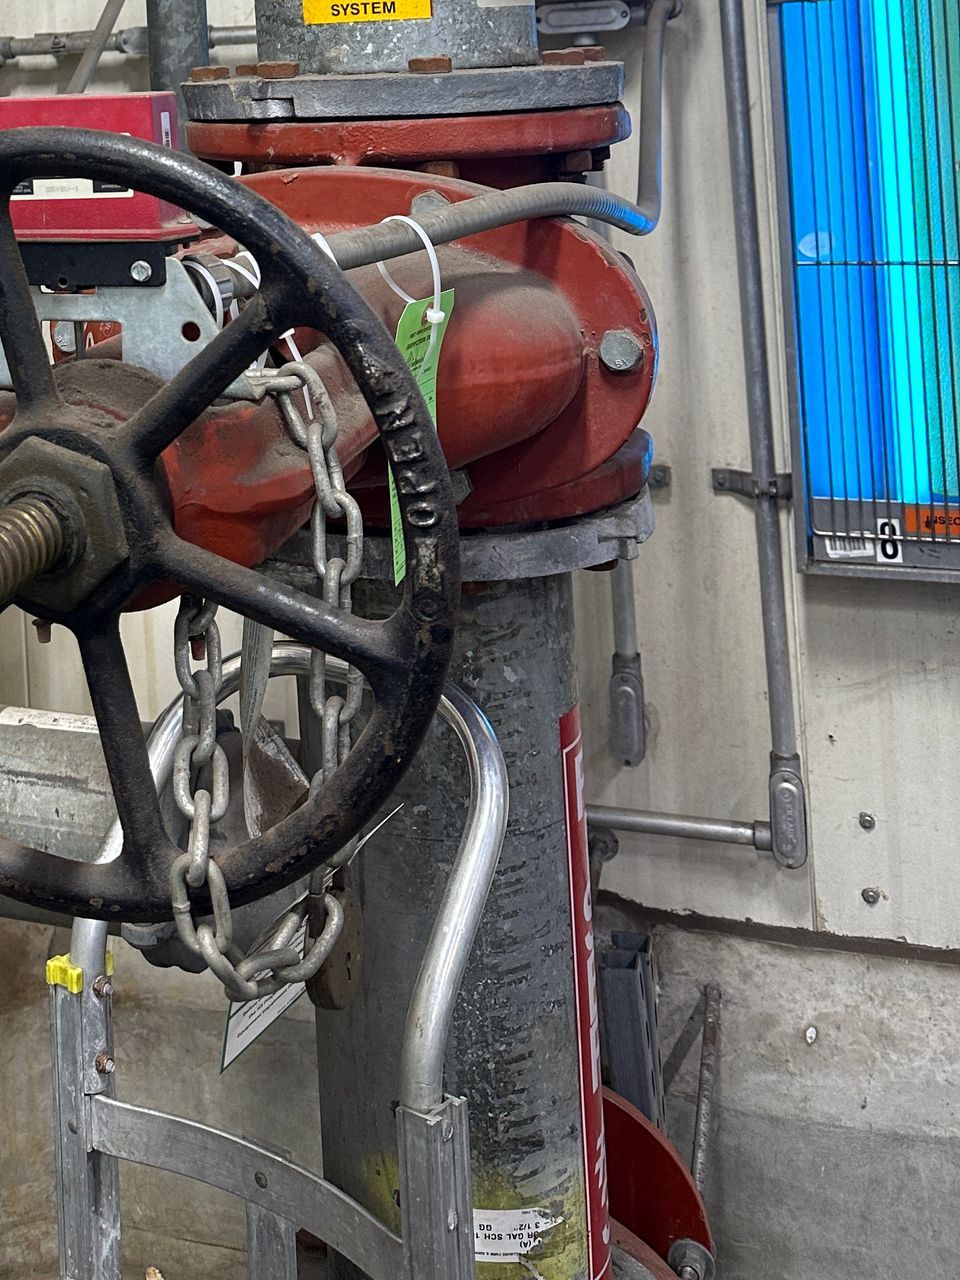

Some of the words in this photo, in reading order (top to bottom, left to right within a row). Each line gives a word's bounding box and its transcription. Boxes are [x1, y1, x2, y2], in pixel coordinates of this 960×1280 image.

[331, 1, 396, 16] SYSTEM
[535, 1221, 540, 1229] 3
[520, 1240, 532, 1248] (A)
